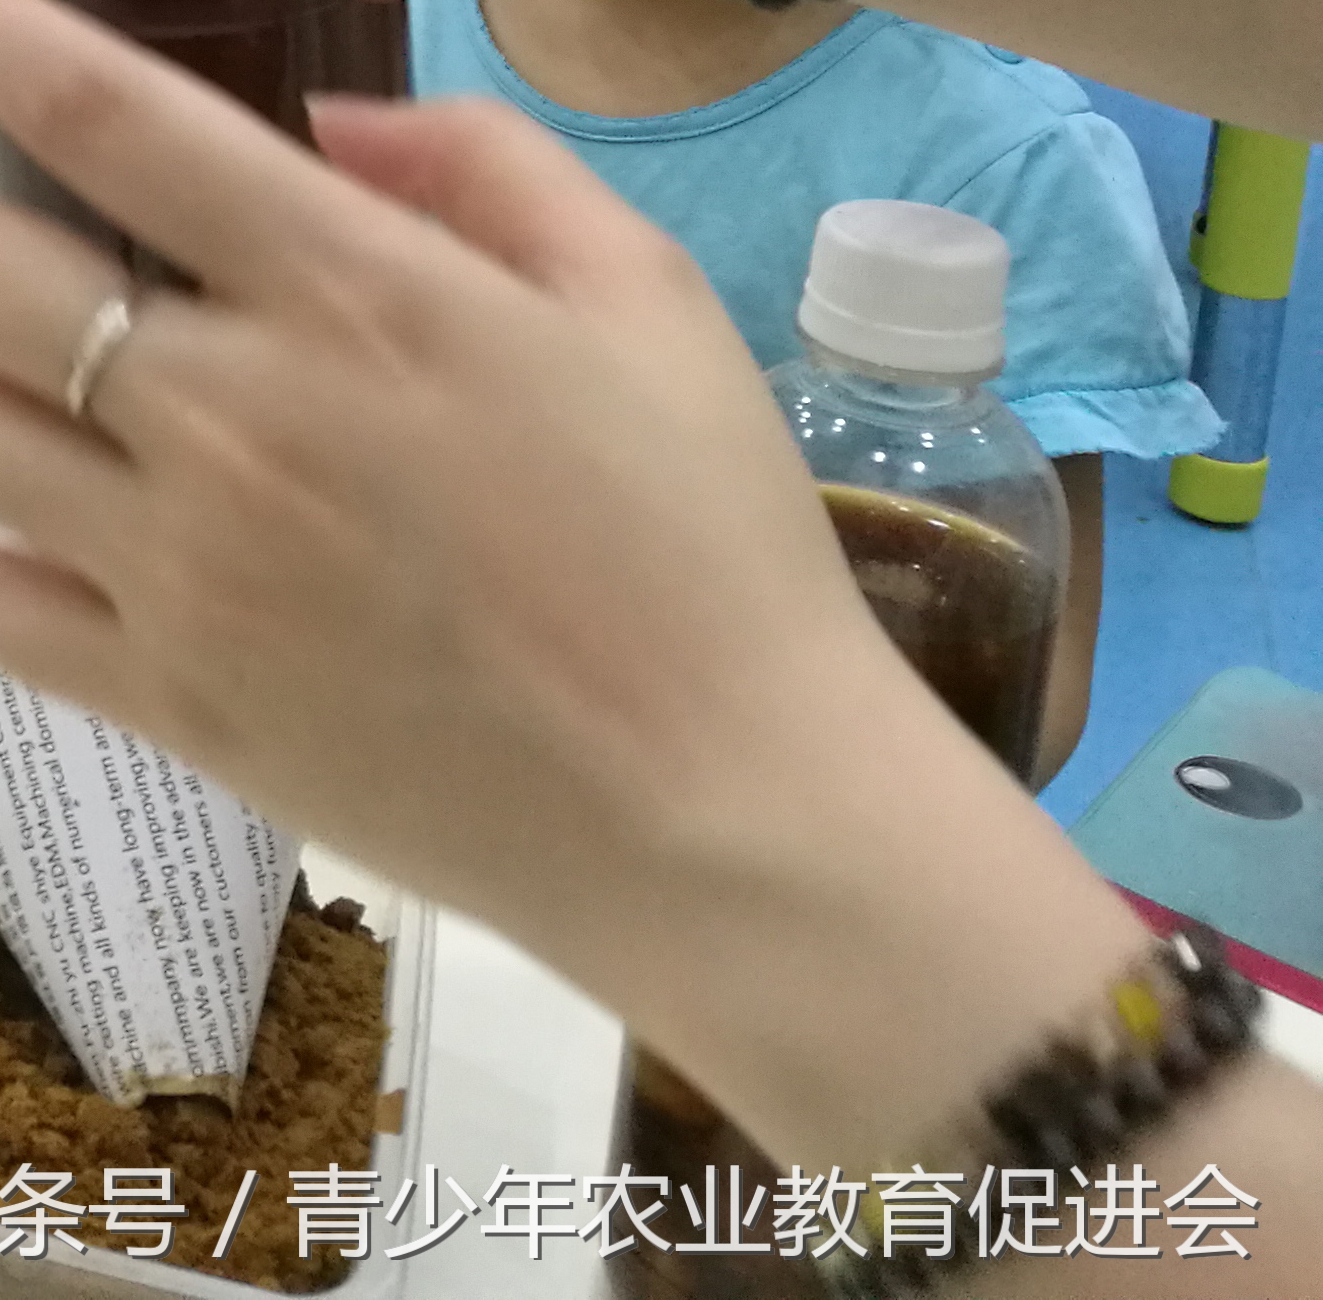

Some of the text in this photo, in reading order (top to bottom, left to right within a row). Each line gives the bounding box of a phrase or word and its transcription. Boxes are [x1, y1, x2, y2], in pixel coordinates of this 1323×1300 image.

[85, 717, 110, 750] and
[100, 756, 138, 852] long-term
[182, 775, 202, 794] all
[171, 809, 190, 841] the
[181, 845, 196, 865] in
[245, 823, 274, 887] quality
[28, 856, 50, 903] shiye
[29, 695, 152, 1088] achine and all kinds of numerical domin
[129, 856, 153, 903] have
[187, 870, 209, 912] now
[160, 863, 192, 942] keeping
[41, 909, 64, 953] CNC
[145, 908, 168, 950] now
[201, 918, 220, 948] are
[222, 908, 239, 940] our
[59, 958, 77, 982] yu
[183, 947, 203, 977] are
[232, 946, 248, 994] from
